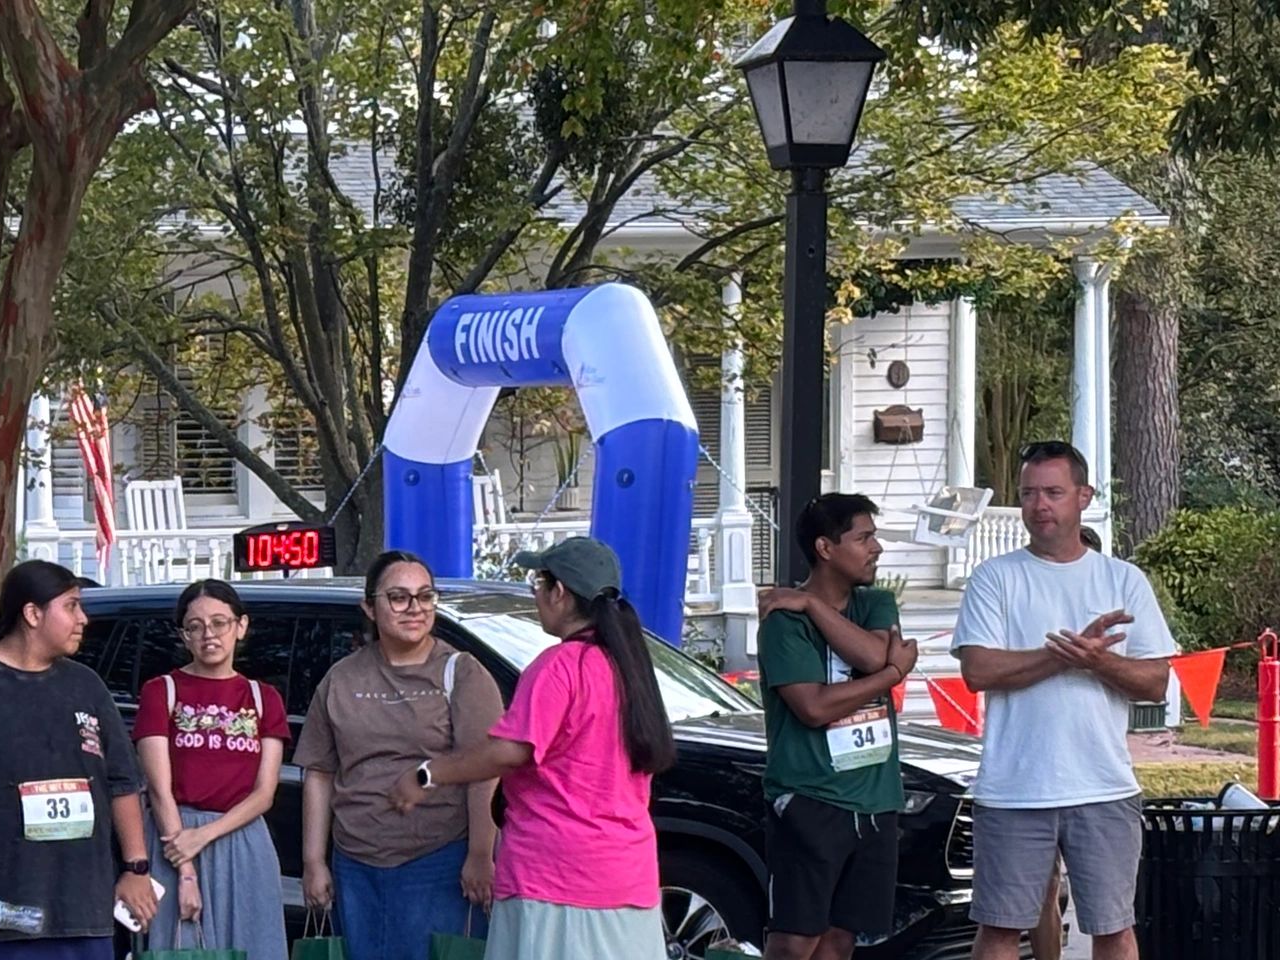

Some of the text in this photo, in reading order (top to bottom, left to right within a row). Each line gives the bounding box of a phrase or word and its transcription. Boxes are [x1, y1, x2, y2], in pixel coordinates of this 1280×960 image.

[455, 306, 545, 364] FINISH
[175, 733, 260, 753] GOD IS GOOD
[851, 726, 875, 748] 34
[46, 797, 70, 819] 33
